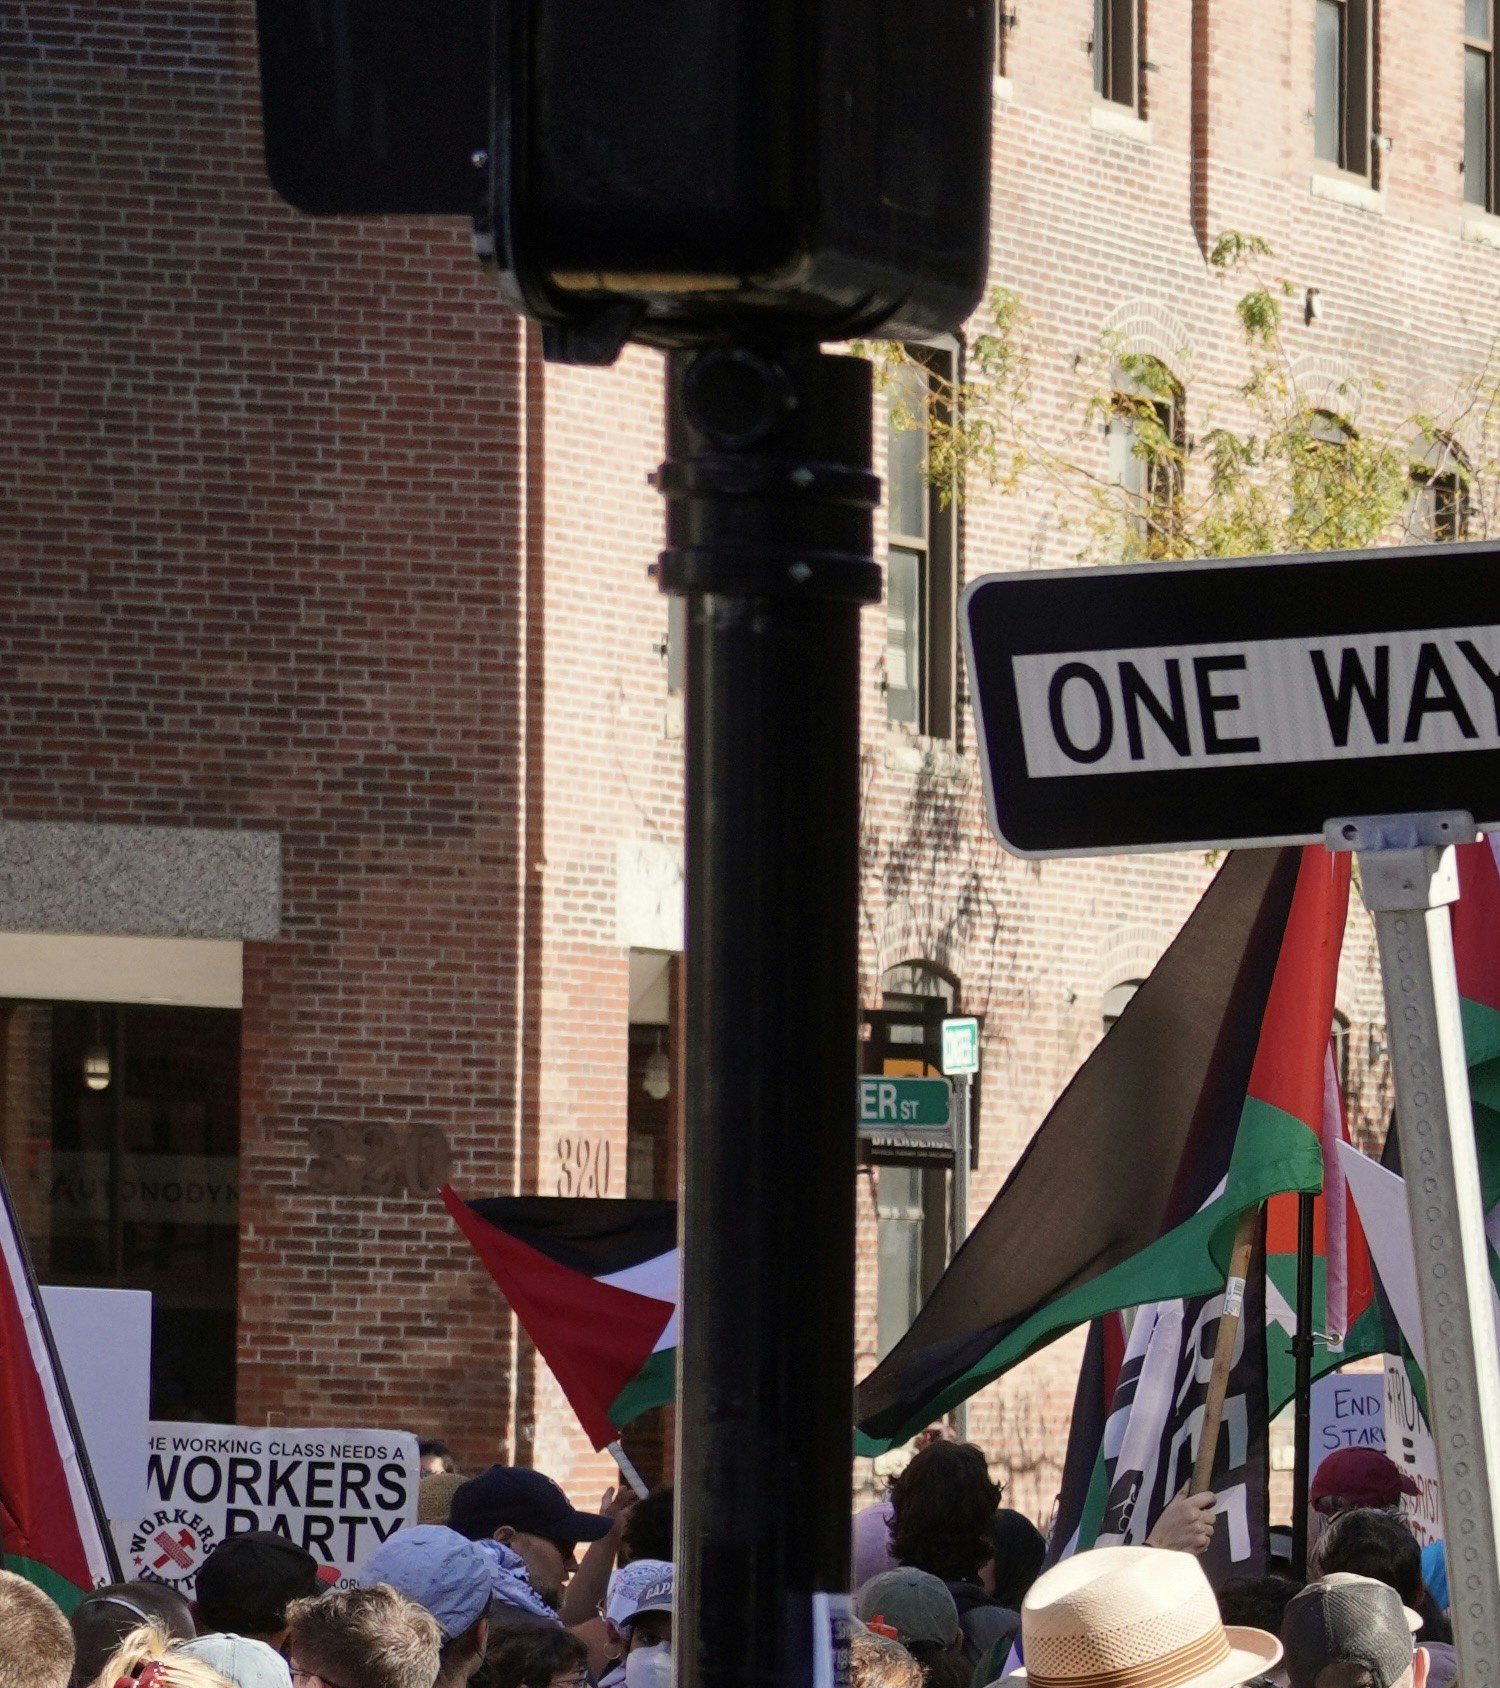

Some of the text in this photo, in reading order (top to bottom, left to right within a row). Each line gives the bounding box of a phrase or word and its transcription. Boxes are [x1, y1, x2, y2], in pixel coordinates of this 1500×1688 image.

[1047, 654, 1259, 765] ONE
[861, 1083, 919, 1119] ER ST
[309, 1121, 449, 1198] 320
[556, 1137, 611, 1198] 320
[1334, 1389, 1380, 1418] END
[149, 1437, 405, 1461] HE WORKING CLASS NEEDS A
[147, 1454, 407, 1511] WORKERS
[130, 1508, 217, 1555] WORKERS
